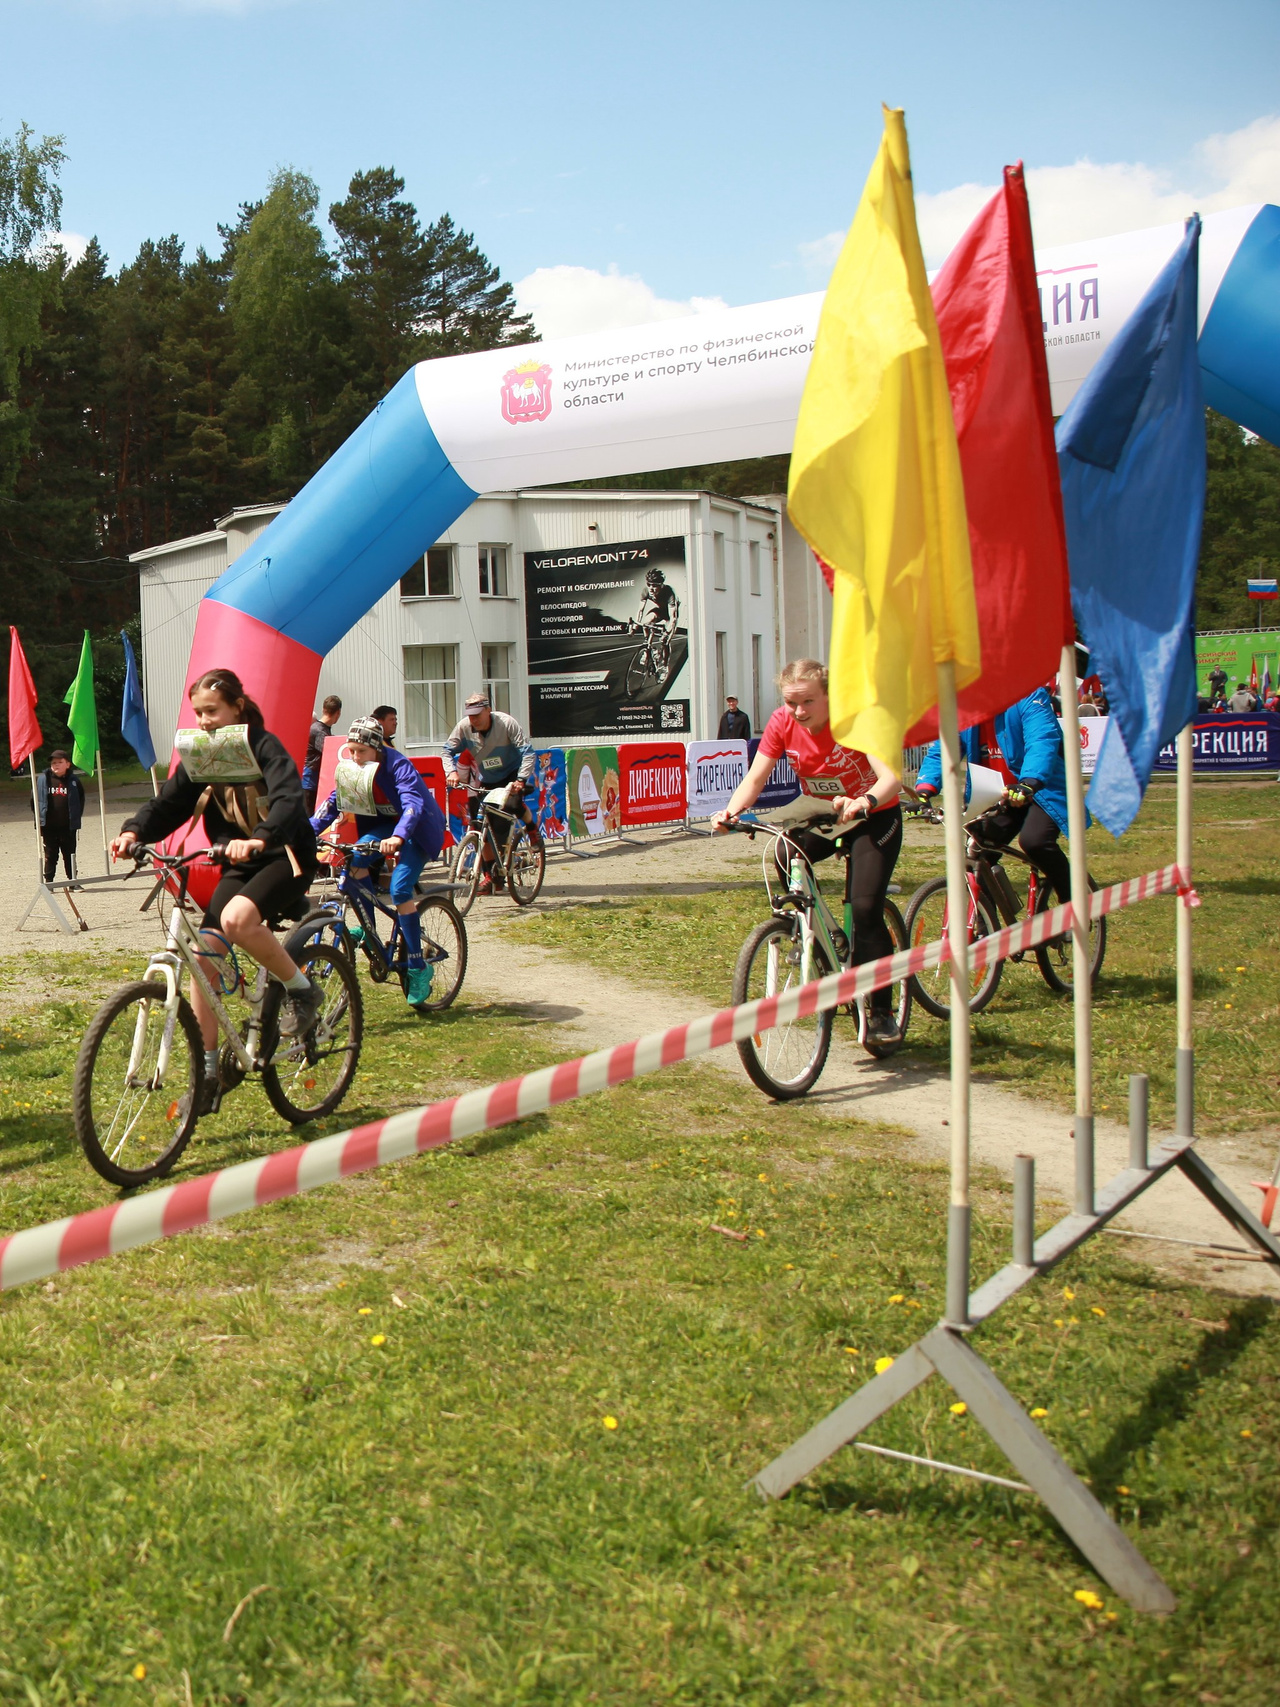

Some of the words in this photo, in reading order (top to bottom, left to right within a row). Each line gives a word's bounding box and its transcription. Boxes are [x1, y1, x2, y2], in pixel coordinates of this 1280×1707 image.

[1038, 278, 1099, 332] ИЯ
[1065, 331, 1100, 344] ОБЛАСТИ
[564, 348, 675, 372] Министерство
[679, 343, 699, 355] по
[703, 324, 804, 353] физической
[563, 371, 629, 391] культуре
[634, 368, 644, 380] и
[648, 360, 703, 381] спорту
[706, 338, 818, 369] Челябинской
[563, 391, 625, 409] области
[537, 585, 566, 594] РЕМОНТ
[574, 580, 635, 591] ОБСЛУЖИВАНИЕ
[540, 601, 587, 611] ВЕЛОСИПЕДОВ
[540, 615, 583, 624] СНОУБОРДОВ
[541, 628, 570, 636] БЕГОВЫХ
[577, 626, 604, 634] ГОРНЫХ
[605, 624, 622, 632] ЛЫЖ
[628, 767, 681, 803] ДИРЕКЦИЯ
[696, 763, 743, 795] ДИРЕКЦИЯ
[810, 781, 840, 791] 168
[877, 818, 898, 846] noname
